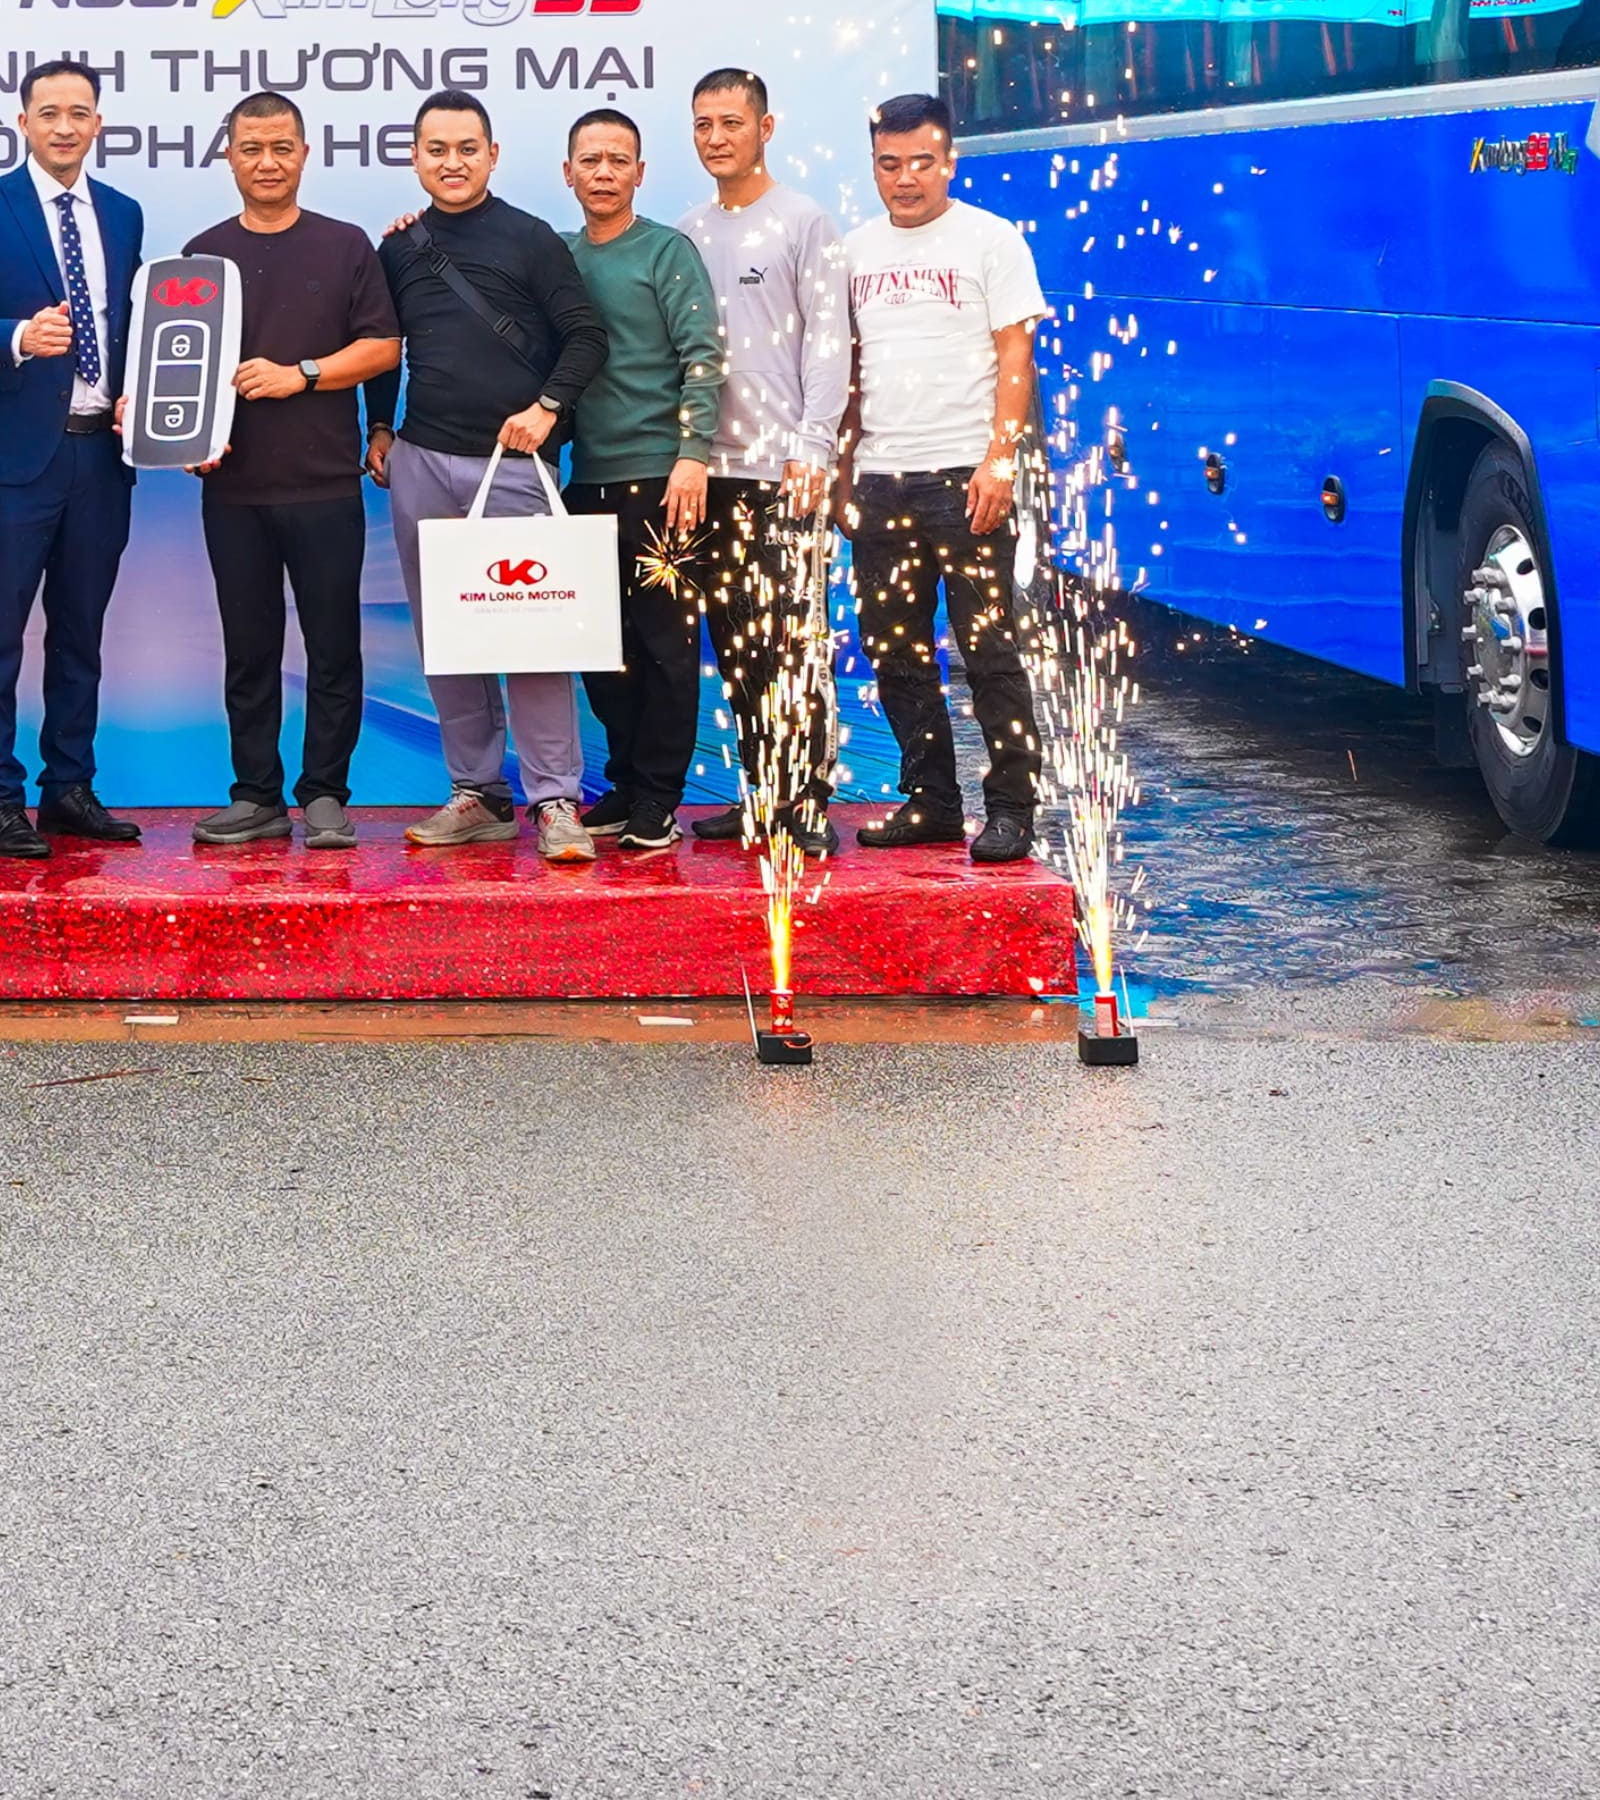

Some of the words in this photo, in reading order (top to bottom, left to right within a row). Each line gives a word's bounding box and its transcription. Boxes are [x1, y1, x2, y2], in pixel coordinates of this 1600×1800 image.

[150, 42, 489, 92] THƯƠNG
[515, 46, 654, 102] MẠI
[852, 268, 961, 312] VIETNAMESE
[459, 591, 487, 602] KIM
[488, 591, 525, 602] LONG
[527, 589, 577, 601] MOTOR
